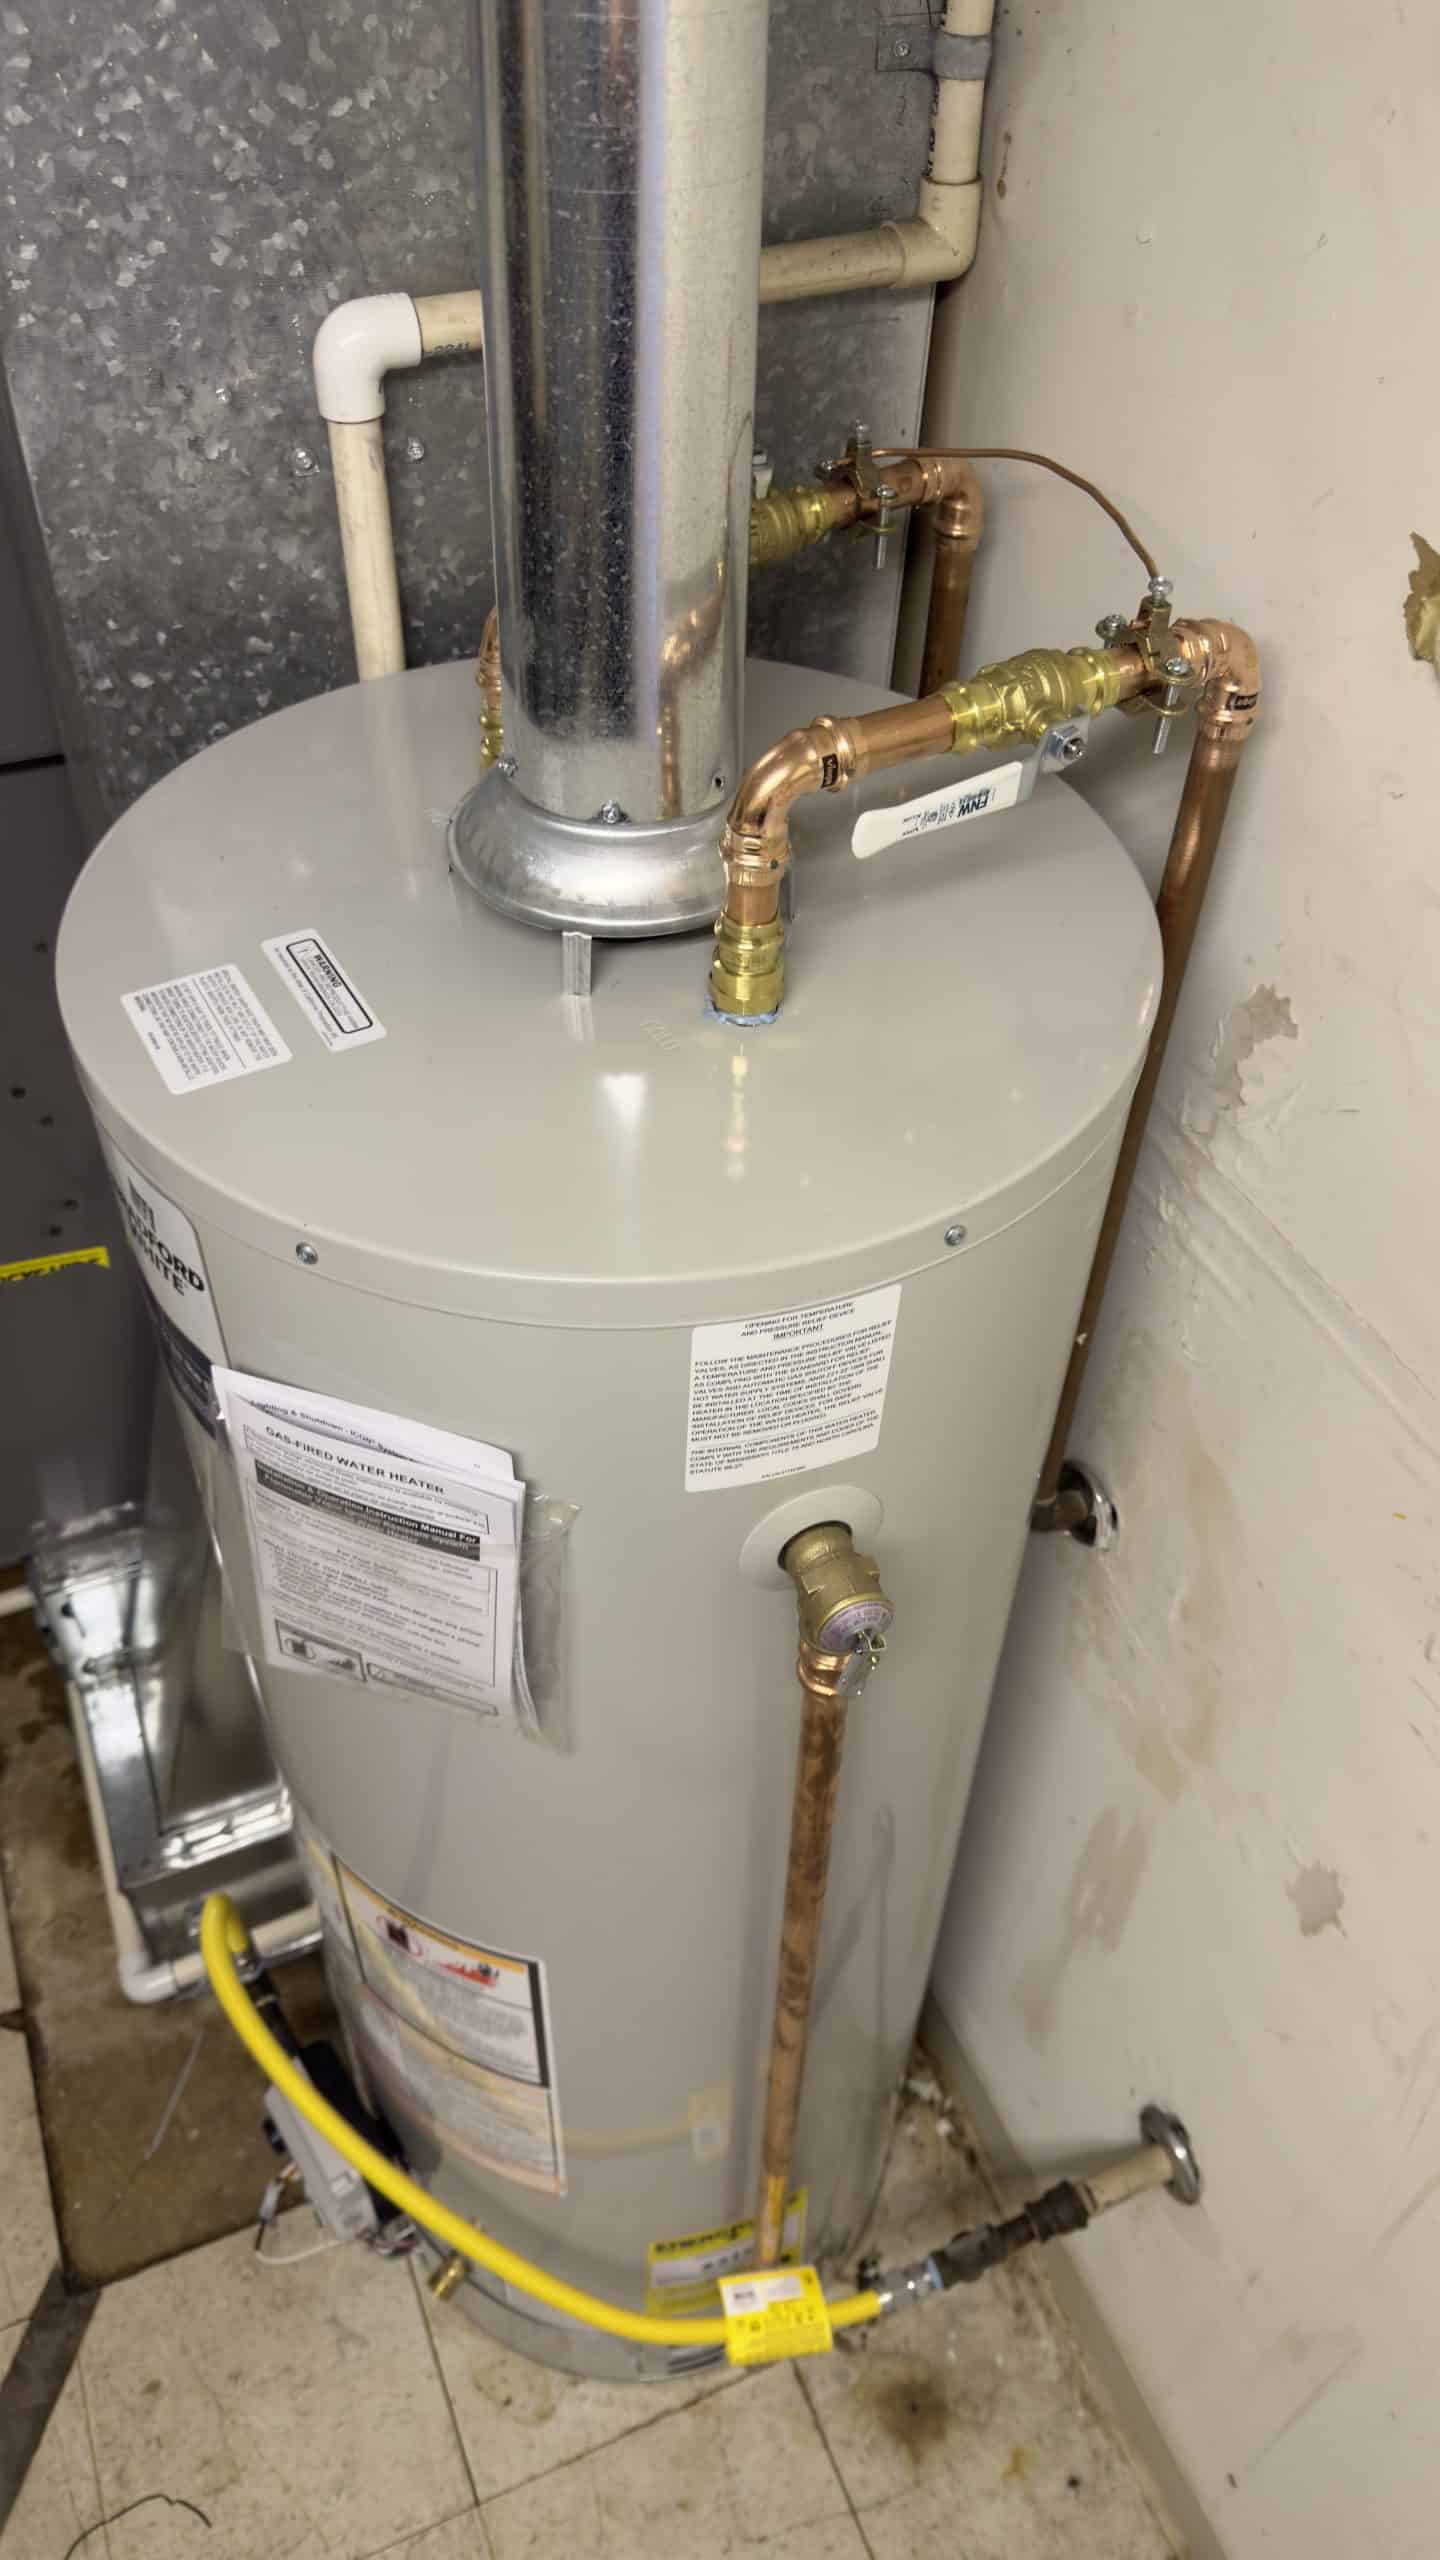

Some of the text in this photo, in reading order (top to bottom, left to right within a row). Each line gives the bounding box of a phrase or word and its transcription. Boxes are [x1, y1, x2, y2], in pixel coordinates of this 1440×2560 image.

[957, 794, 990, 819] FNW
[314, 954, 341, 989] WARNING
[266, 1426, 444, 1494] GAS-FIRED WATER HEATER
[366, 1507, 418, 1530] Instruction
[420, 1523, 457, 1540] Manual
[459, 1533, 477, 1544] For
